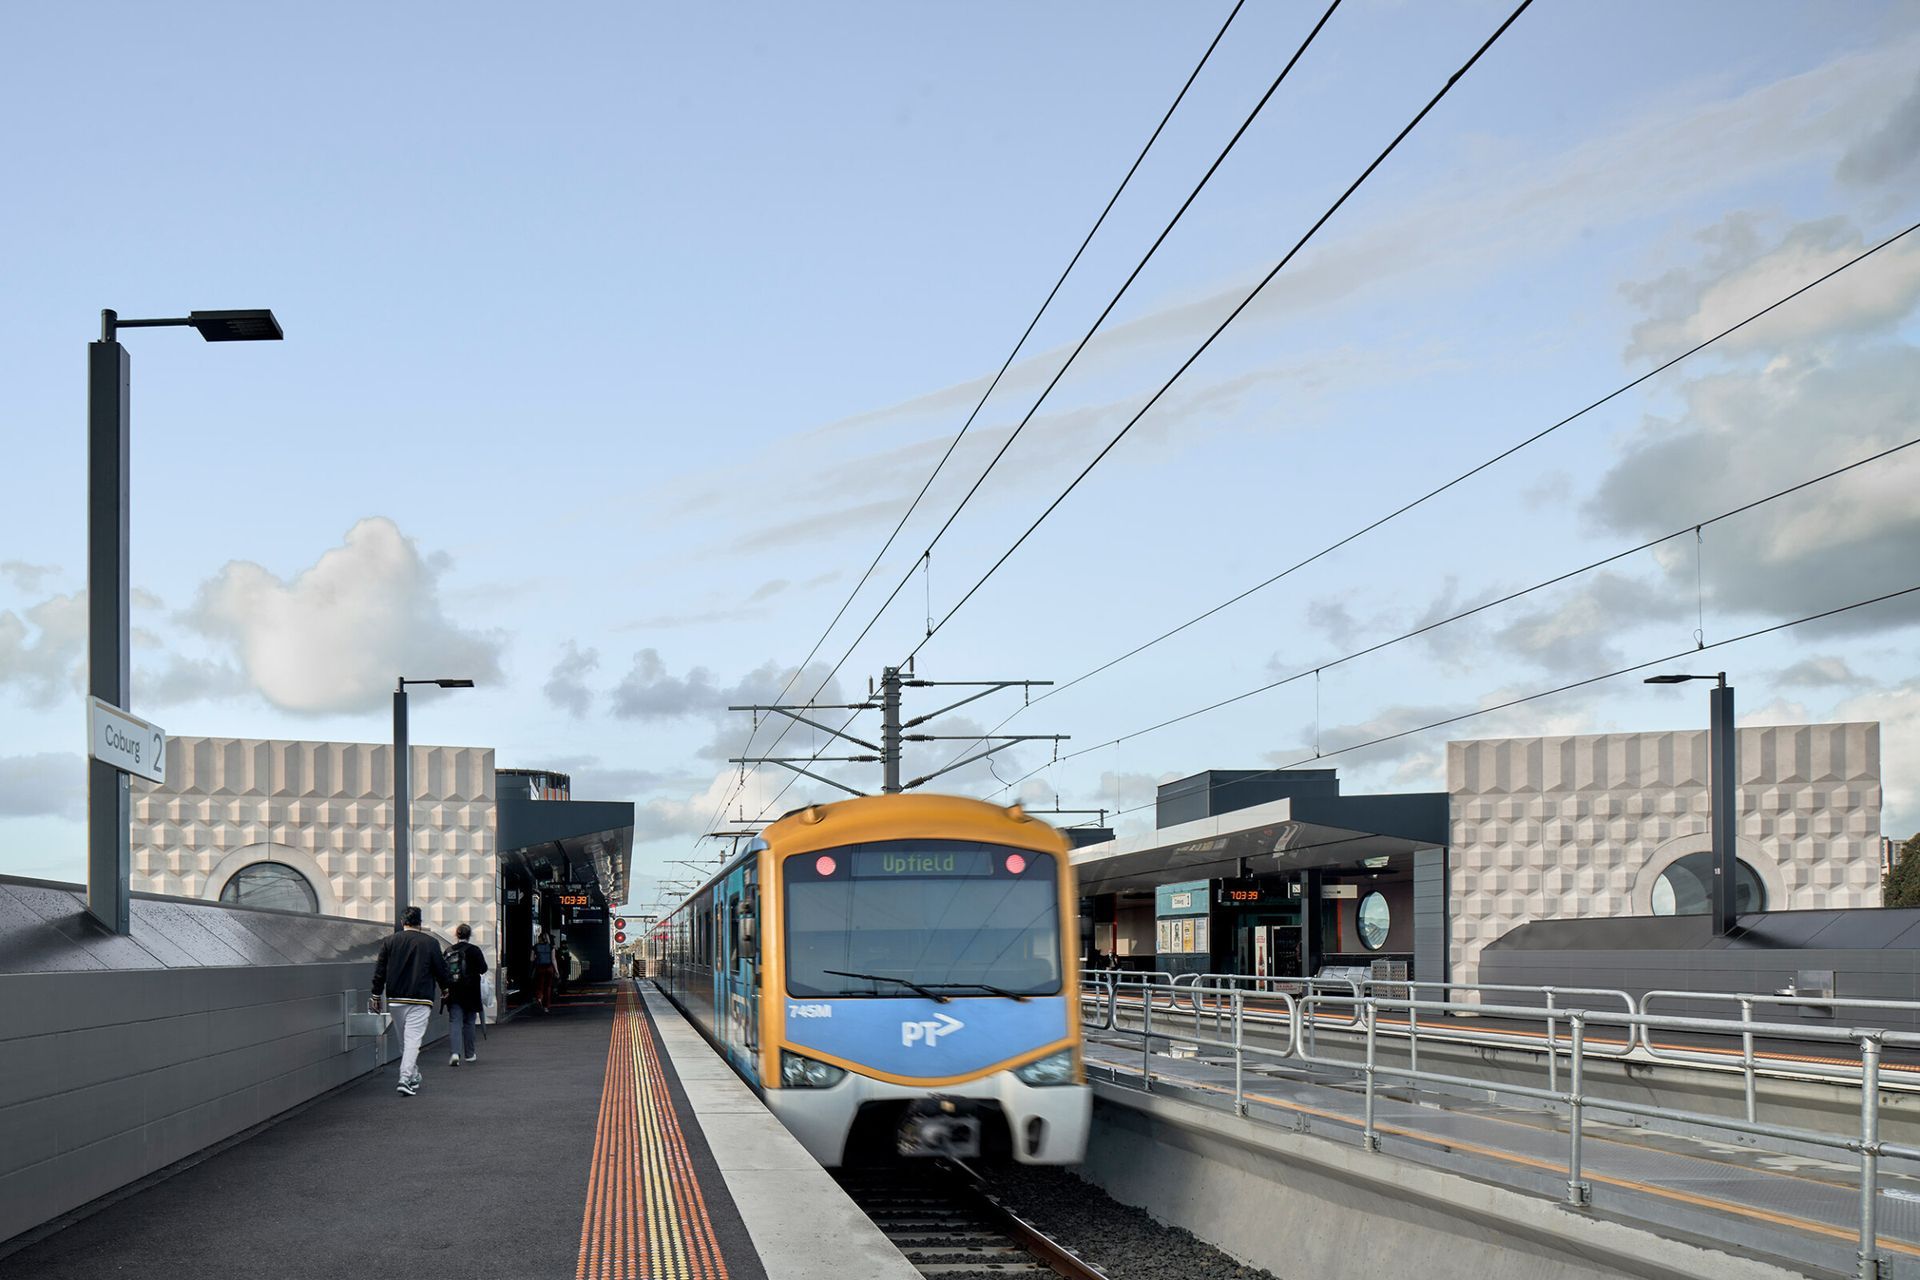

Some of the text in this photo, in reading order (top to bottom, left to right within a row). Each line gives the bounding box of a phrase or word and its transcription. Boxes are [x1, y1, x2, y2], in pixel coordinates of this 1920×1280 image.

[105, 724, 163, 773] Coburg 2
[883, 854, 954, 873] Upfield
